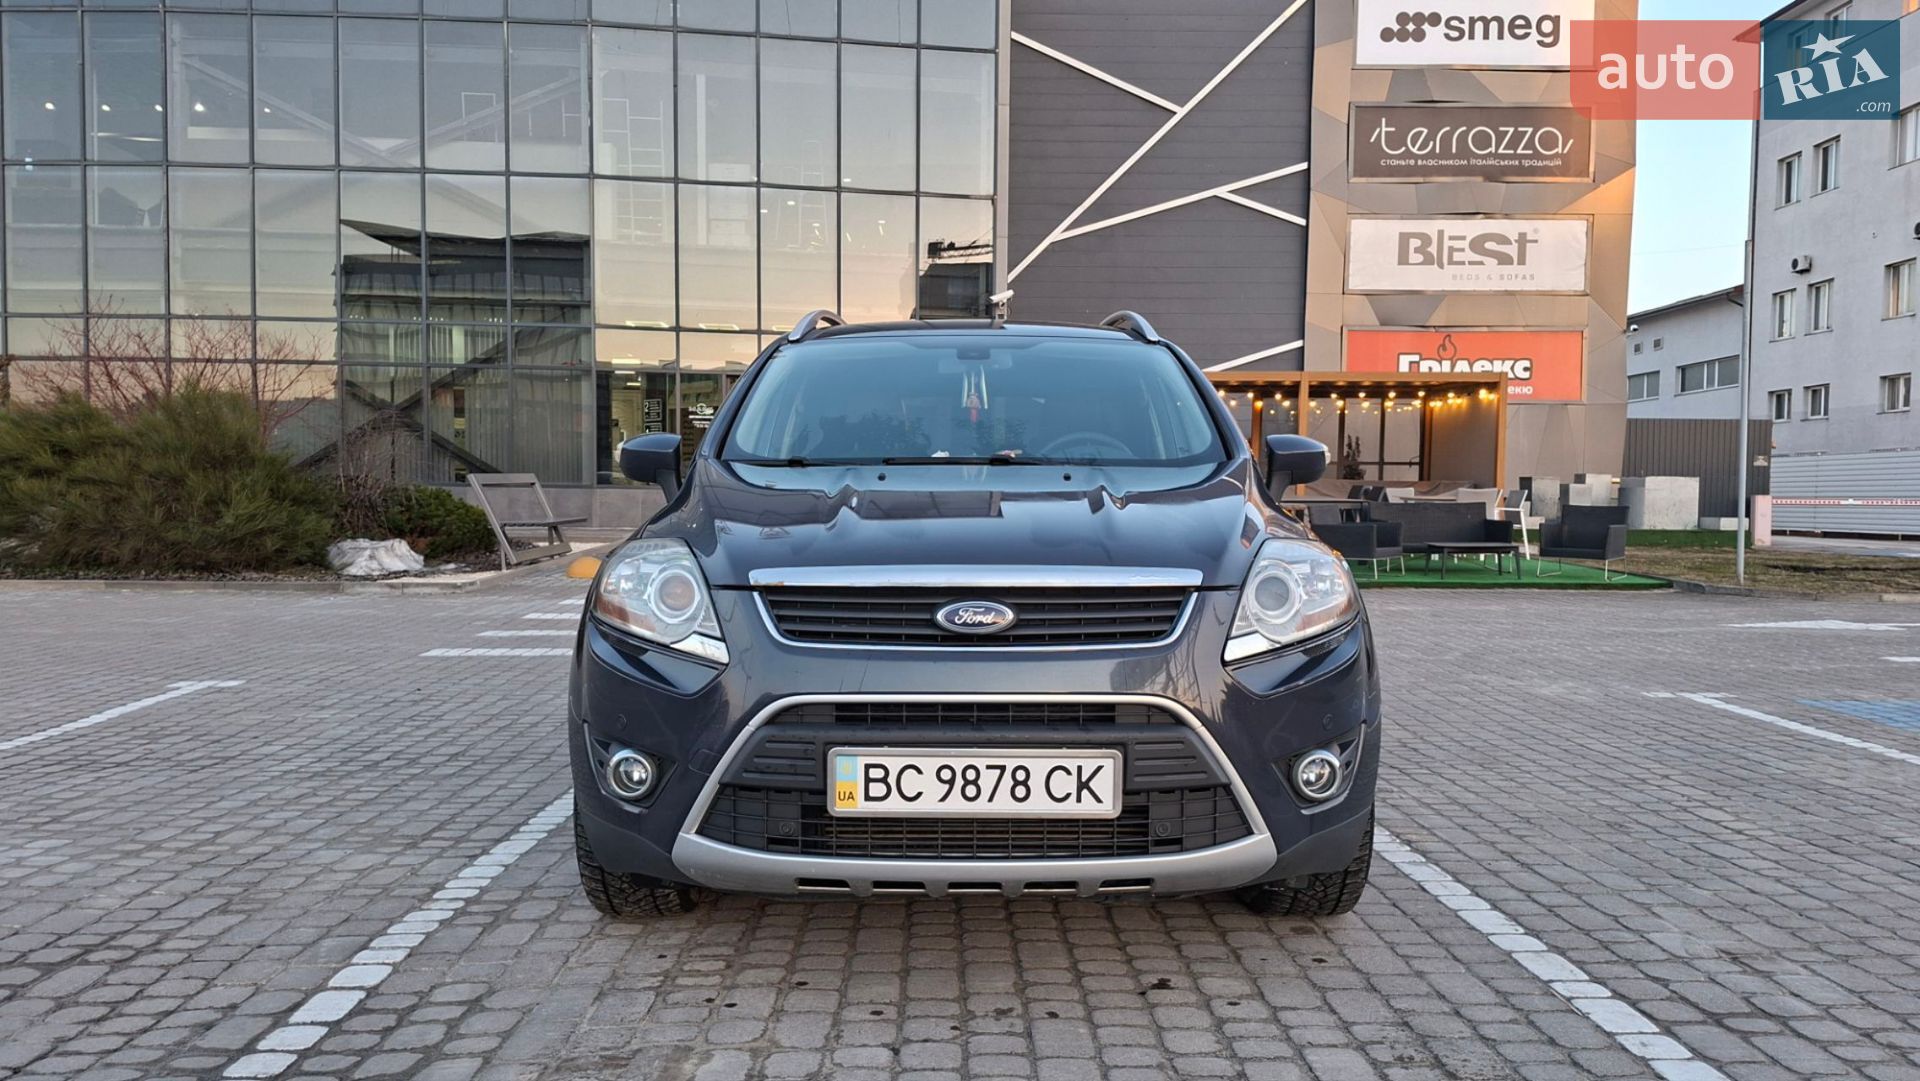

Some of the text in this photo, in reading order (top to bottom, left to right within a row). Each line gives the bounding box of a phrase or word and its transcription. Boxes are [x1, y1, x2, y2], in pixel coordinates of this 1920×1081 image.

[1443, 14, 1561, 48] smeg
[1370, 117, 1574, 155] terrazza
[1380, 157, 1562, 168] станьте власником італійських традицій
[1451, 273, 1481, 281] BEDS
[1499, 273, 1535, 281] SOFAS
[954, 607, 996, 624] Ford
[863, 762, 1105, 804] BC 9878 CK
[837, 790, 856, 802] UA
